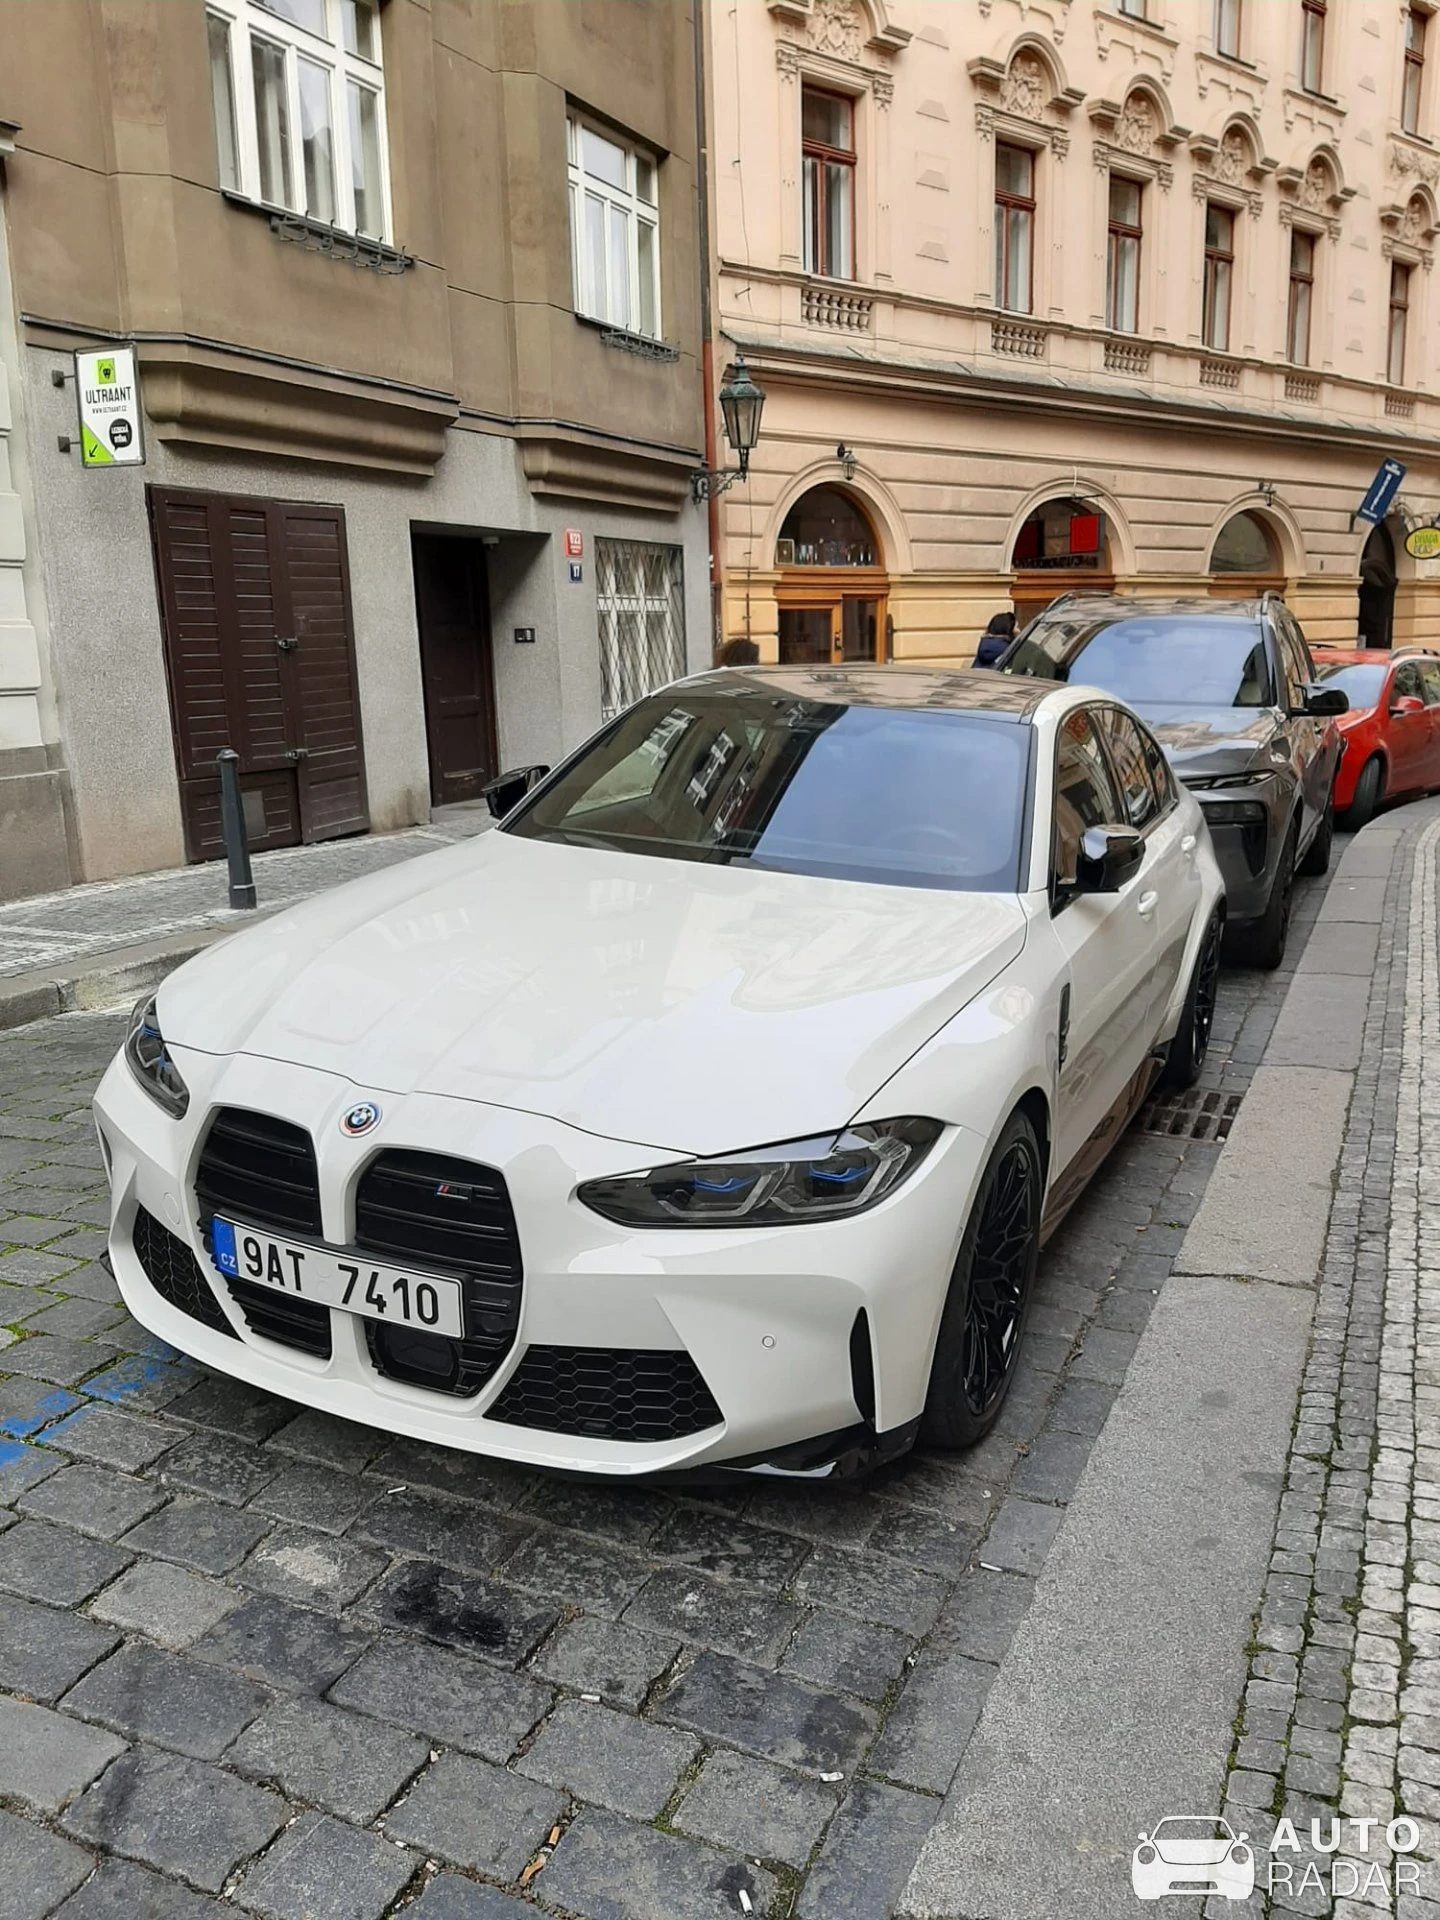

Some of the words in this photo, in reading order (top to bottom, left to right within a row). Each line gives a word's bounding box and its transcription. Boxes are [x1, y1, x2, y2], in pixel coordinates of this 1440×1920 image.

[85, 386, 132, 404] ULTRAANT
[220, 1253, 237, 1268] CZ
[243, 1236, 305, 1292] 9AT
[337, 1263, 439, 1325] 7410
